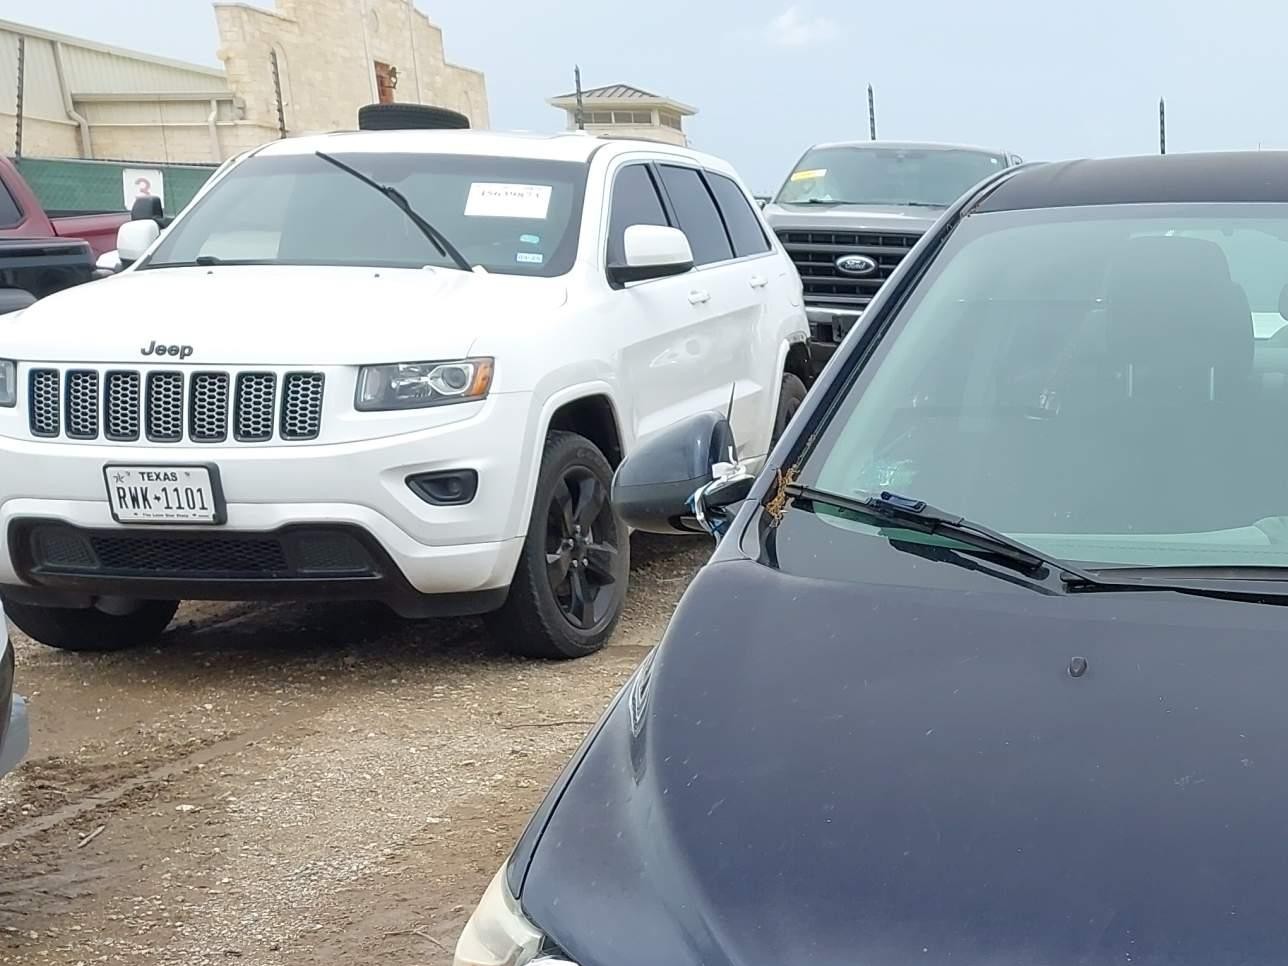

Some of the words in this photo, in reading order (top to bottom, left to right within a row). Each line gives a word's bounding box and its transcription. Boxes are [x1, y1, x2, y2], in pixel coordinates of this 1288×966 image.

[140, 340, 194, 360] Jeep
[138, 471, 178, 482] TEXAS
[116, 486, 153, 510] RWK
[161, 486, 209, 511] 1101
